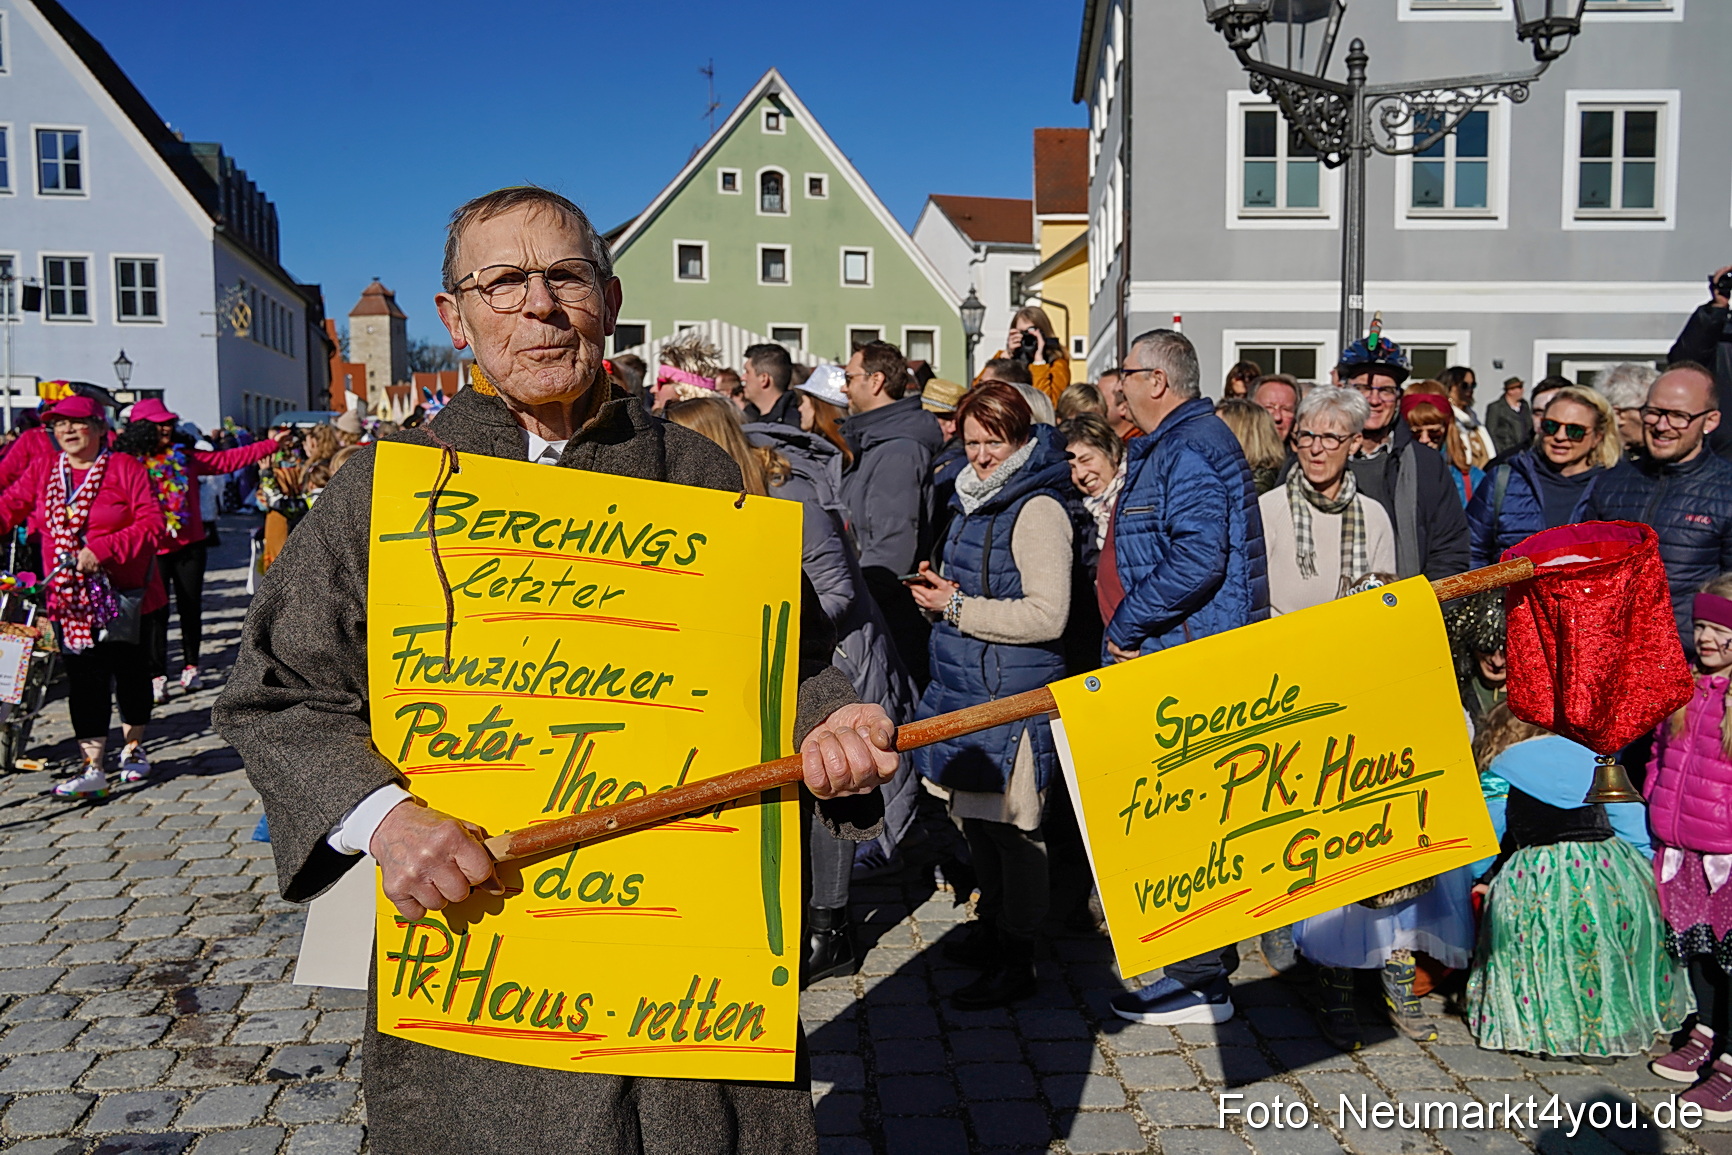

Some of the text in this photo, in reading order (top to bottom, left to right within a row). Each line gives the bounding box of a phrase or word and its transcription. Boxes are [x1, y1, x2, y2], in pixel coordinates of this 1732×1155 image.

[450, 558, 625, 609] letzter
[1154, 673, 1301, 760] Spende
[533, 842, 645, 907] das
